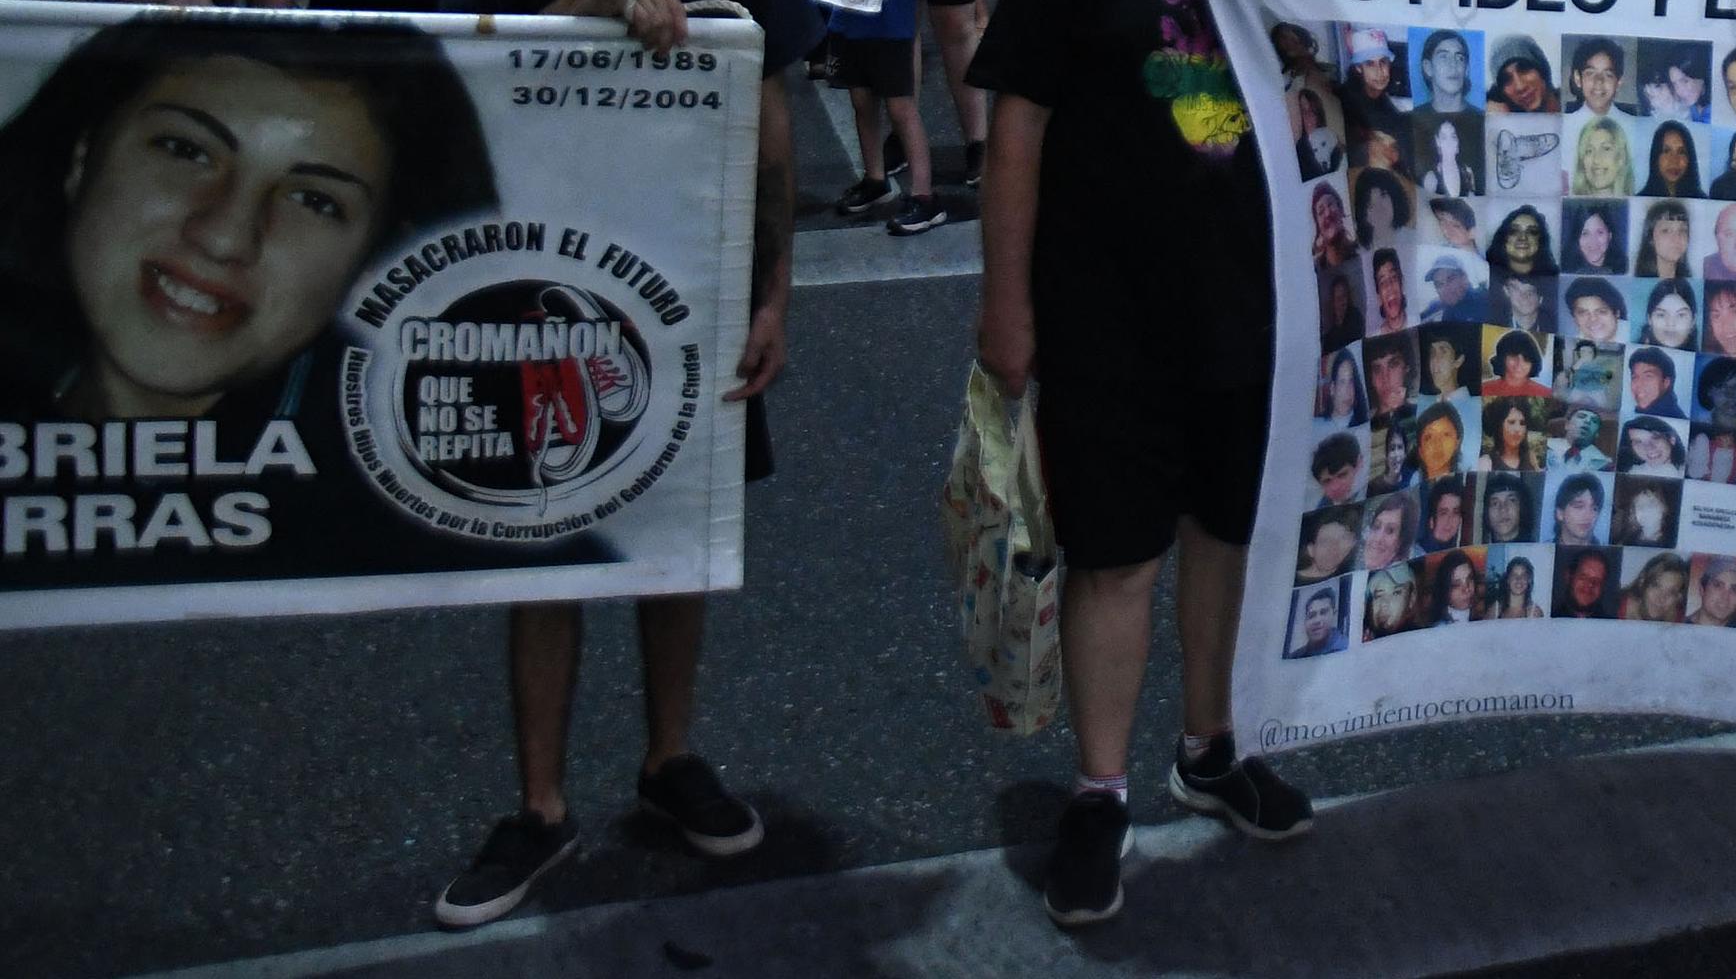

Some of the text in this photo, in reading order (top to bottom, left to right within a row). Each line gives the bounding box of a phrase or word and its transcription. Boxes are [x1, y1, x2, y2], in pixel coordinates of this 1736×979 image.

[508, 48, 718, 72] 17/06/1989
[512, 85, 722, 111] 30/12/2004
[355, 221, 692, 329] MASACRARON EL FUTURO
[419, 376, 474, 406] QUE
[418, 404, 499, 434] NO SE
[418, 431, 516, 461] REPITA
[4, 491, 273, 554] RRAS
[1259, 692, 1576, 754] @movimientocromanon
